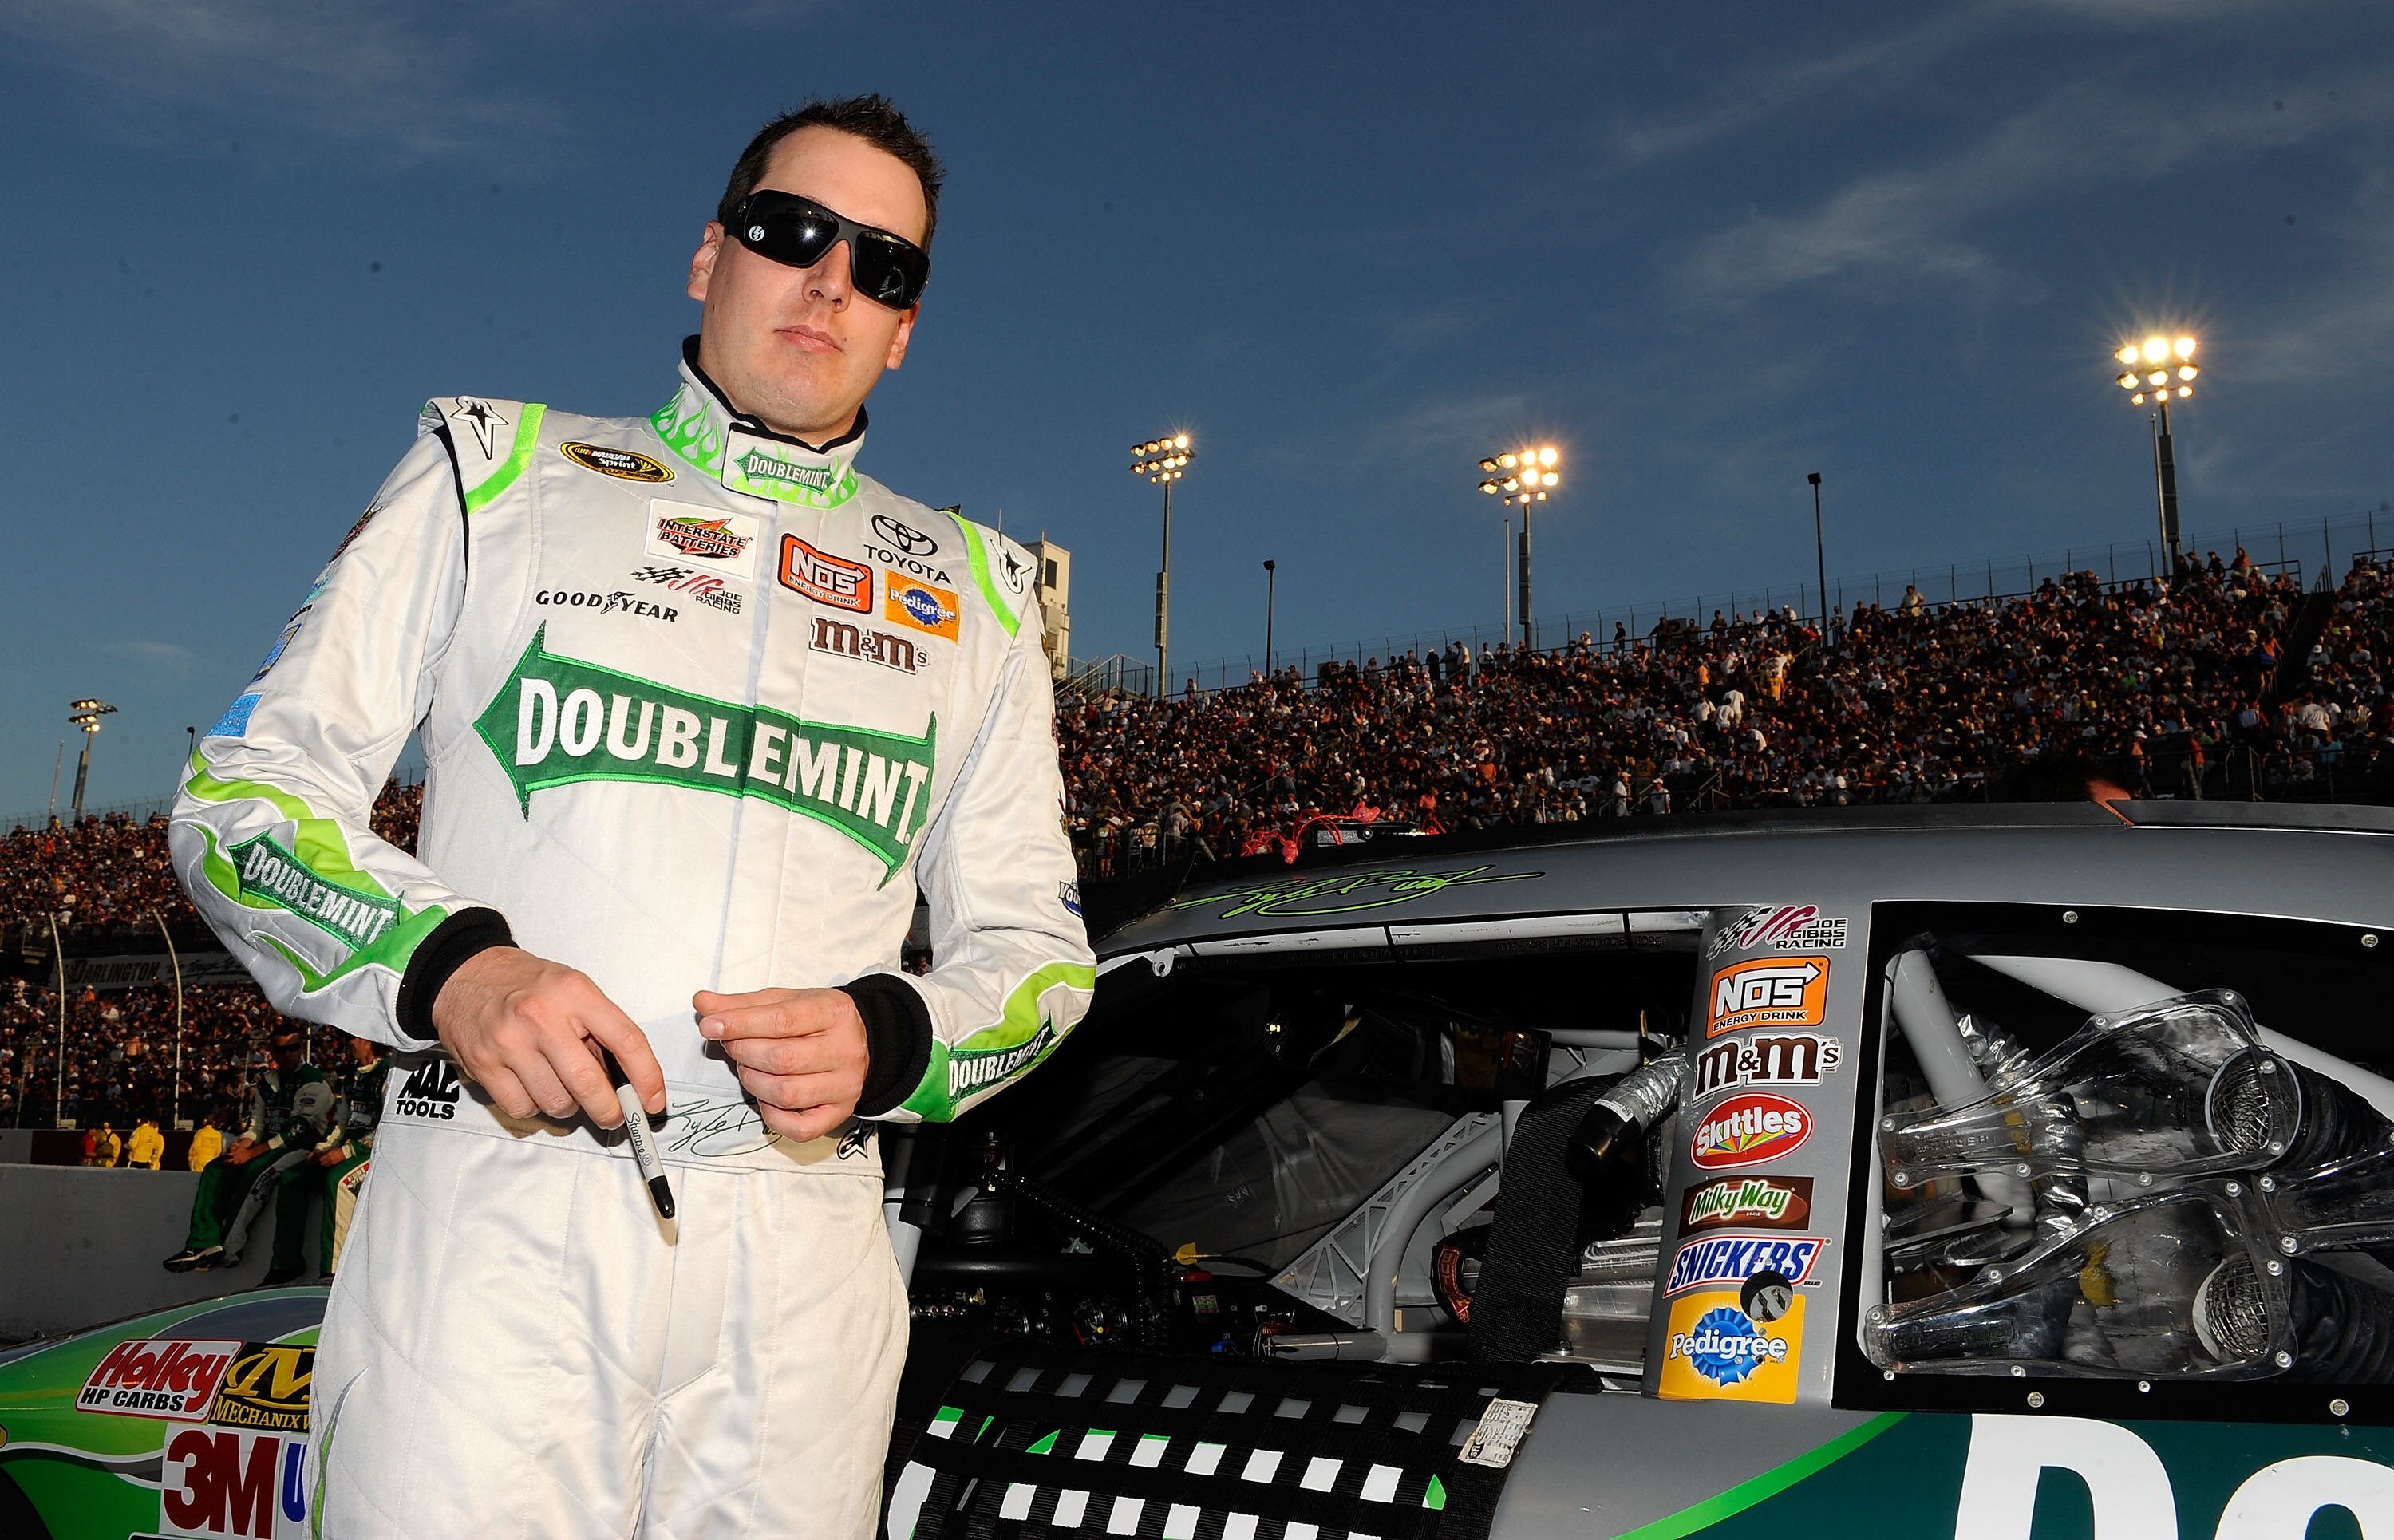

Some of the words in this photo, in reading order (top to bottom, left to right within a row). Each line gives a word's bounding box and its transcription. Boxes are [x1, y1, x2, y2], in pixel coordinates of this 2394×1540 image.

[591, 451, 630, 461] NASCAR
[598, 457, 636, 469] Sprint
[747, 454, 831, 489] DOUBLEMINT
[658, 519, 747, 547] INTERSTATE
[660, 531, 739, 557] BATTERIES
[791, 545, 859, 596] NOS
[863, 544, 952, 584] TOYOTA
[695, 594, 741, 614] RACING
[705, 591, 742, 608] GIBBS
[717, 590, 743, 601] JOE
[788, 575, 827, 598] ENERGY
[826, 593, 861, 606] DRINK
[889, 587, 956, 621] Pedigree
[515, 677, 929, 845] DOUBLEMINT
[243, 842, 394, 945] DOUBLEMINT
[1790, 929, 1845, 939] GIBBS
[1807, 919, 1847, 929] JOE
[1776, 938, 1844, 950] RACING
[72, 959, 160, 985] DARLINGTON
[1715, 964, 1807, 1018] NOS
[1713, 1012, 1757, 1032] ENERGY
[1760, 1010, 1807, 1021] DRINK
[948, 1027, 1049, 1097] DOUBLEMINT
[397, 1059, 460, 1103] MAC
[396, 1100, 456, 1120] TOOLS
[625, 1112, 647, 1159] Sharpie
[1696, 1106, 1802, 1157] Skittles
[1672, 1239, 1815, 1288] SNICKERS
[1669, 1329, 1787, 1360] Pedigree
[91, 1342, 230, 1412] Holley
[80, 1388, 110, 1406] HP
[112, 1390, 185, 1412] CARBS
[211, 1396, 300, 1429] MECHANIX
[164, 1429, 281, 1540] 3M
